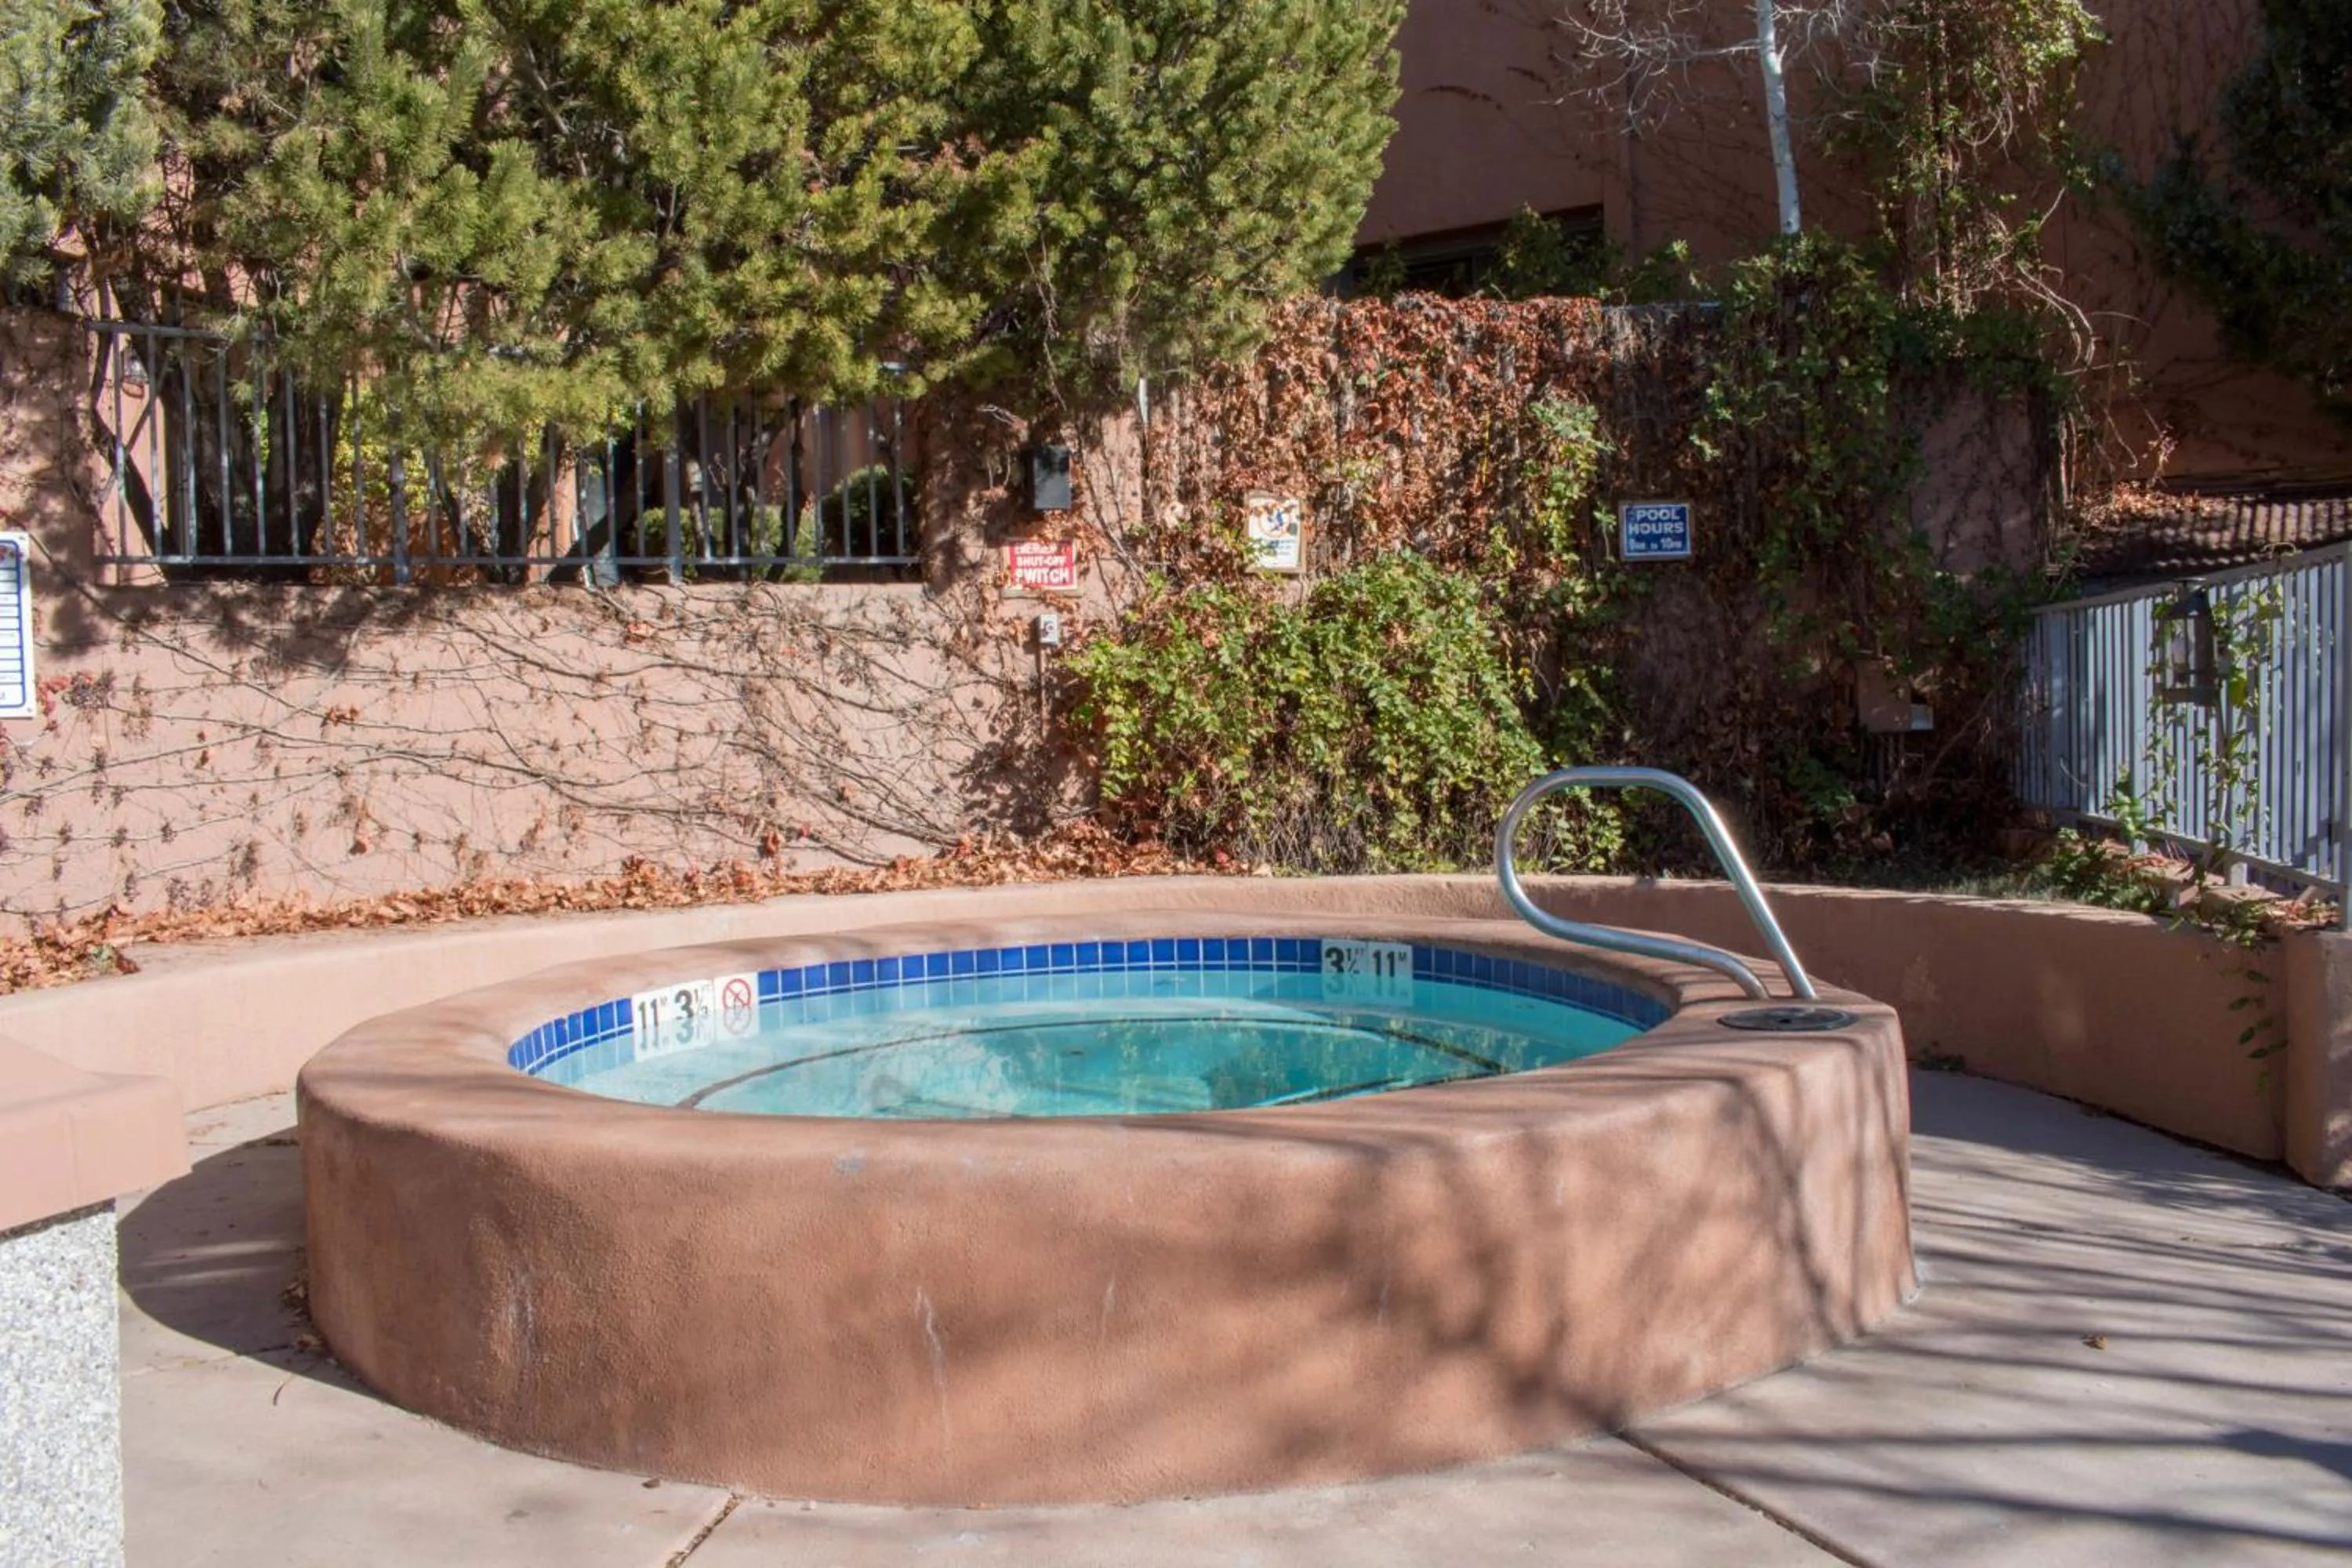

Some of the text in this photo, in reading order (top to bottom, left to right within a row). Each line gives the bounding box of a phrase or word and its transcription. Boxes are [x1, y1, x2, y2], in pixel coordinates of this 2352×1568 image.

[1636, 508, 1681, 522] POOL
[1628, 521, 1685, 535] HOURS
[1016, 555, 1067, 566] SHUT-OFF
[1015, 568, 1069, 583] SWITCH
